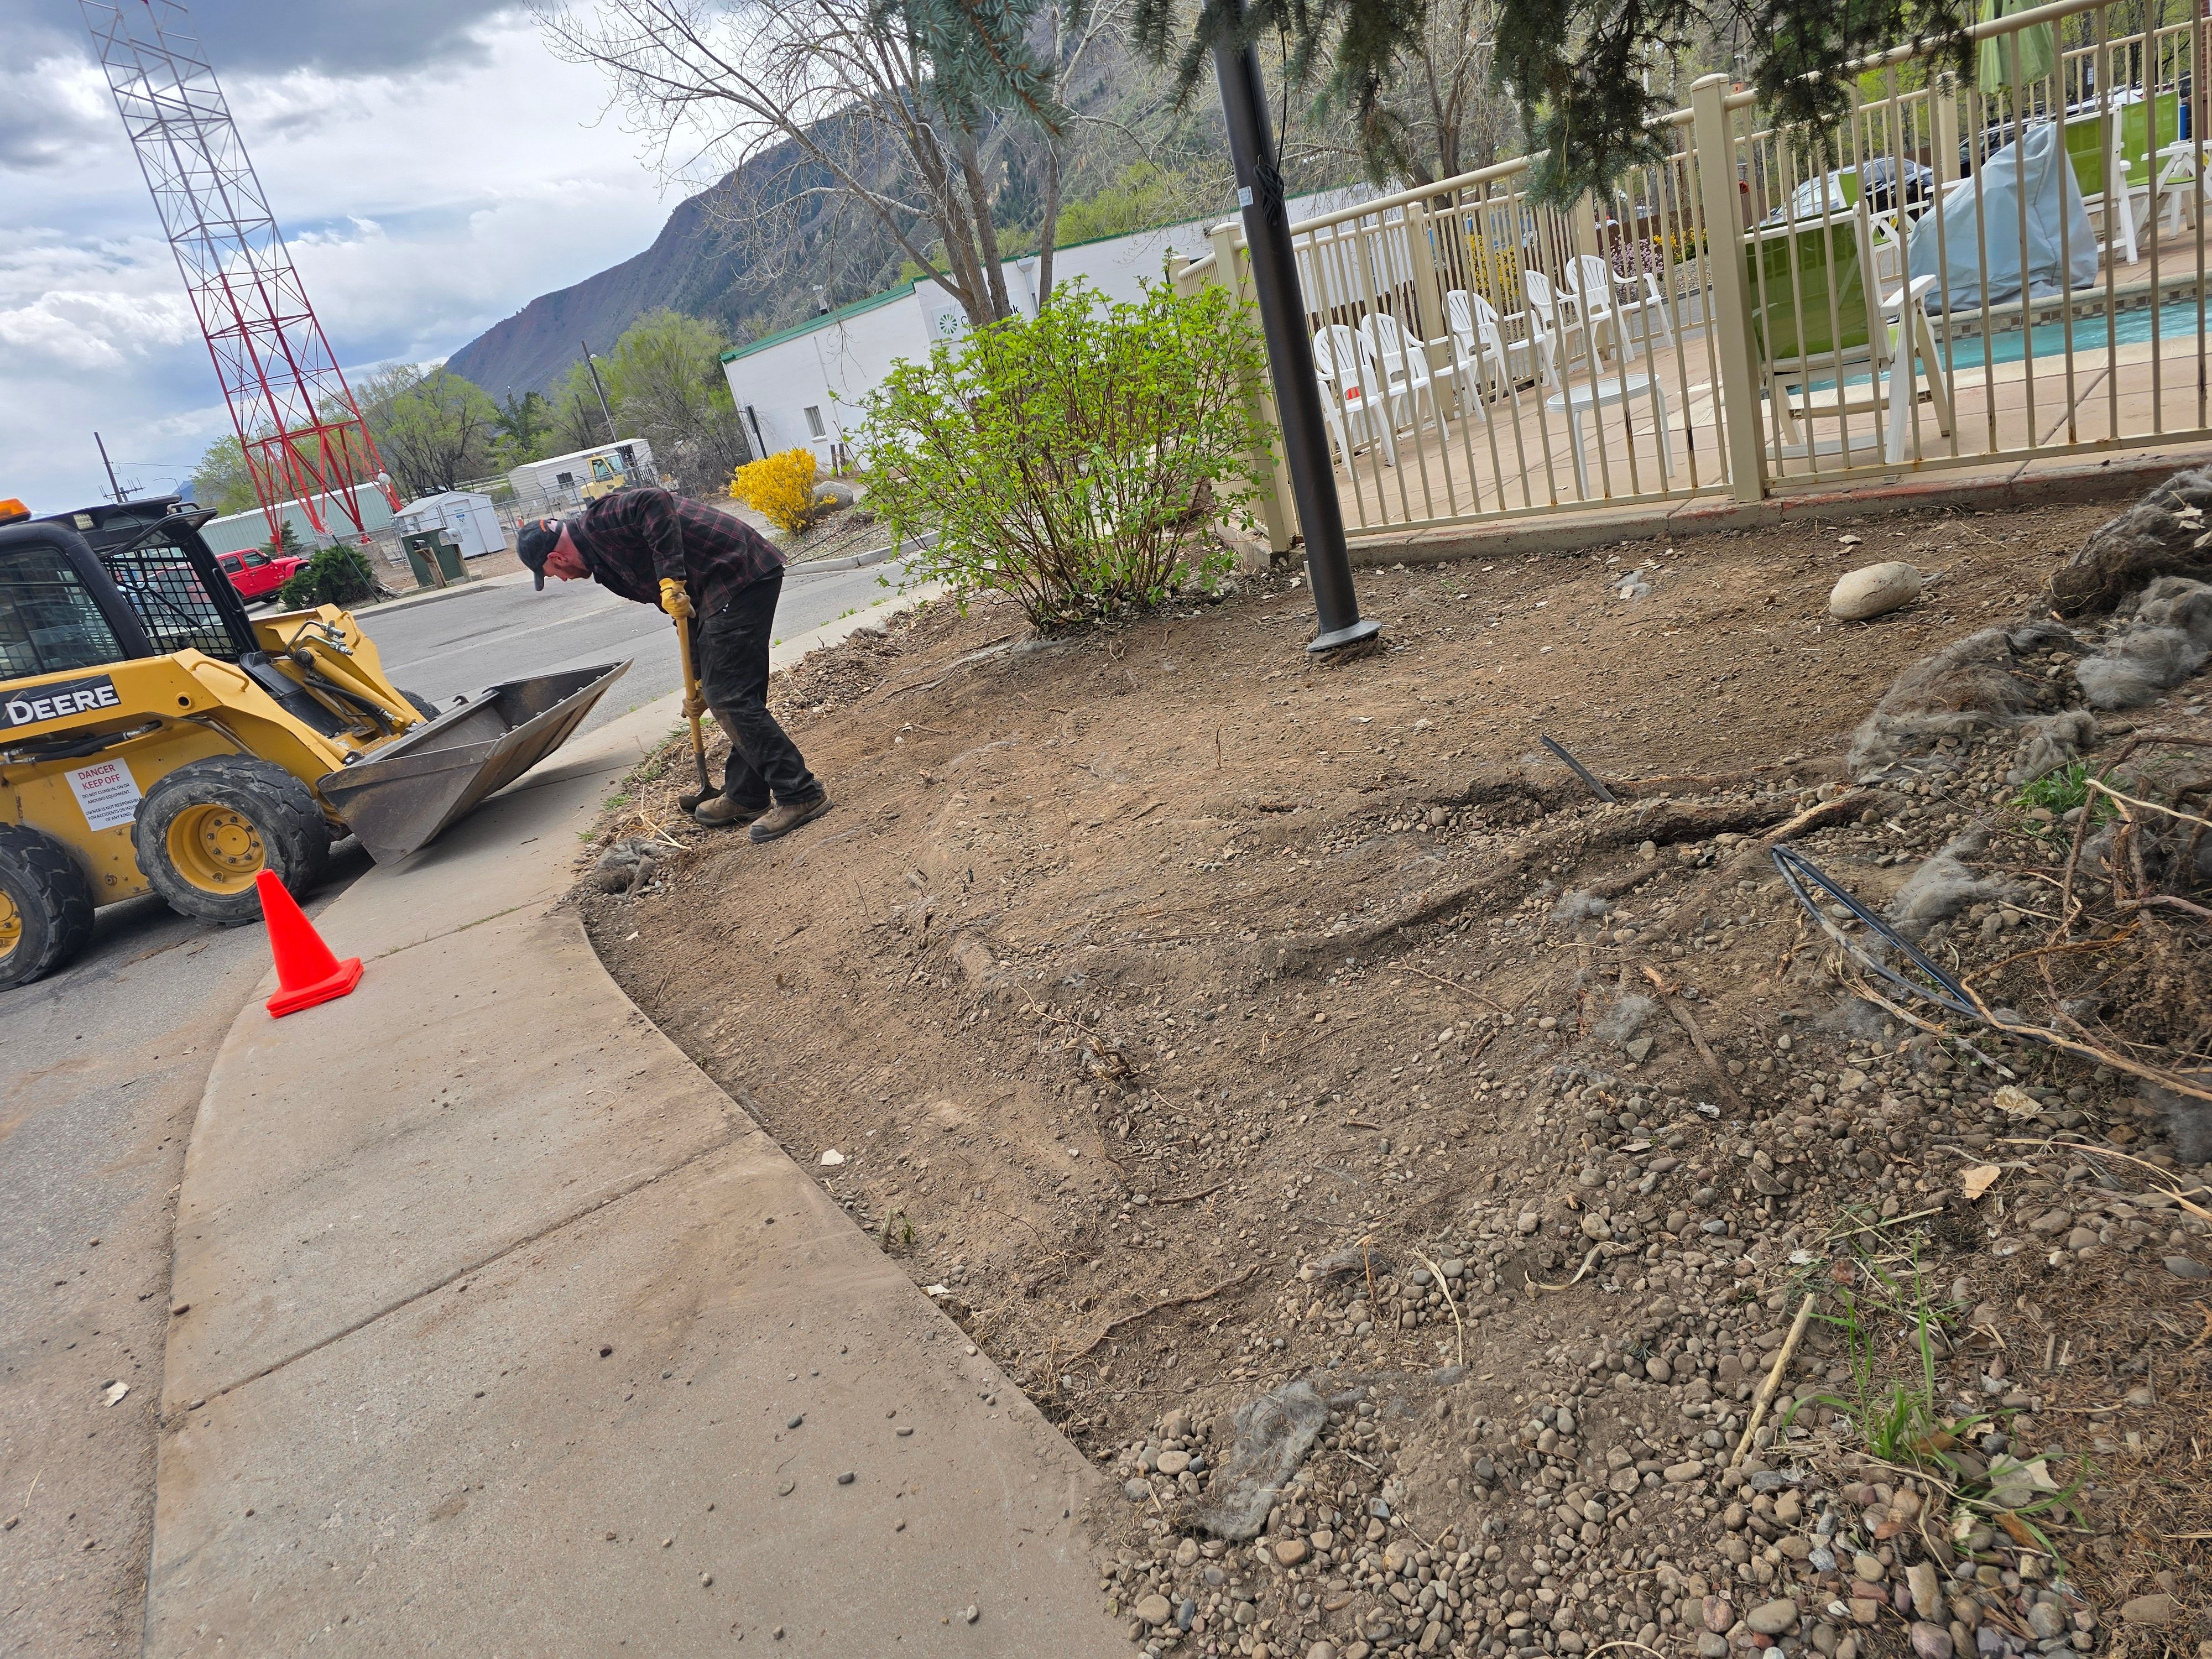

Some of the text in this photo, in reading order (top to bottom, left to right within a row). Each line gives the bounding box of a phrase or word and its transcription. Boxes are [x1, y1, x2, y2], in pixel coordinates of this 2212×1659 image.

[6, 685, 119, 725] DEERE
[78, 764, 116, 780] DANGER
[82, 774, 120, 790] KEEP OFF
[106, 790, 131, 800] EQUIPMENT.
[114, 797, 142, 808] RESPONSIBLE
[97, 810, 119, 818] ACCIDENTS
